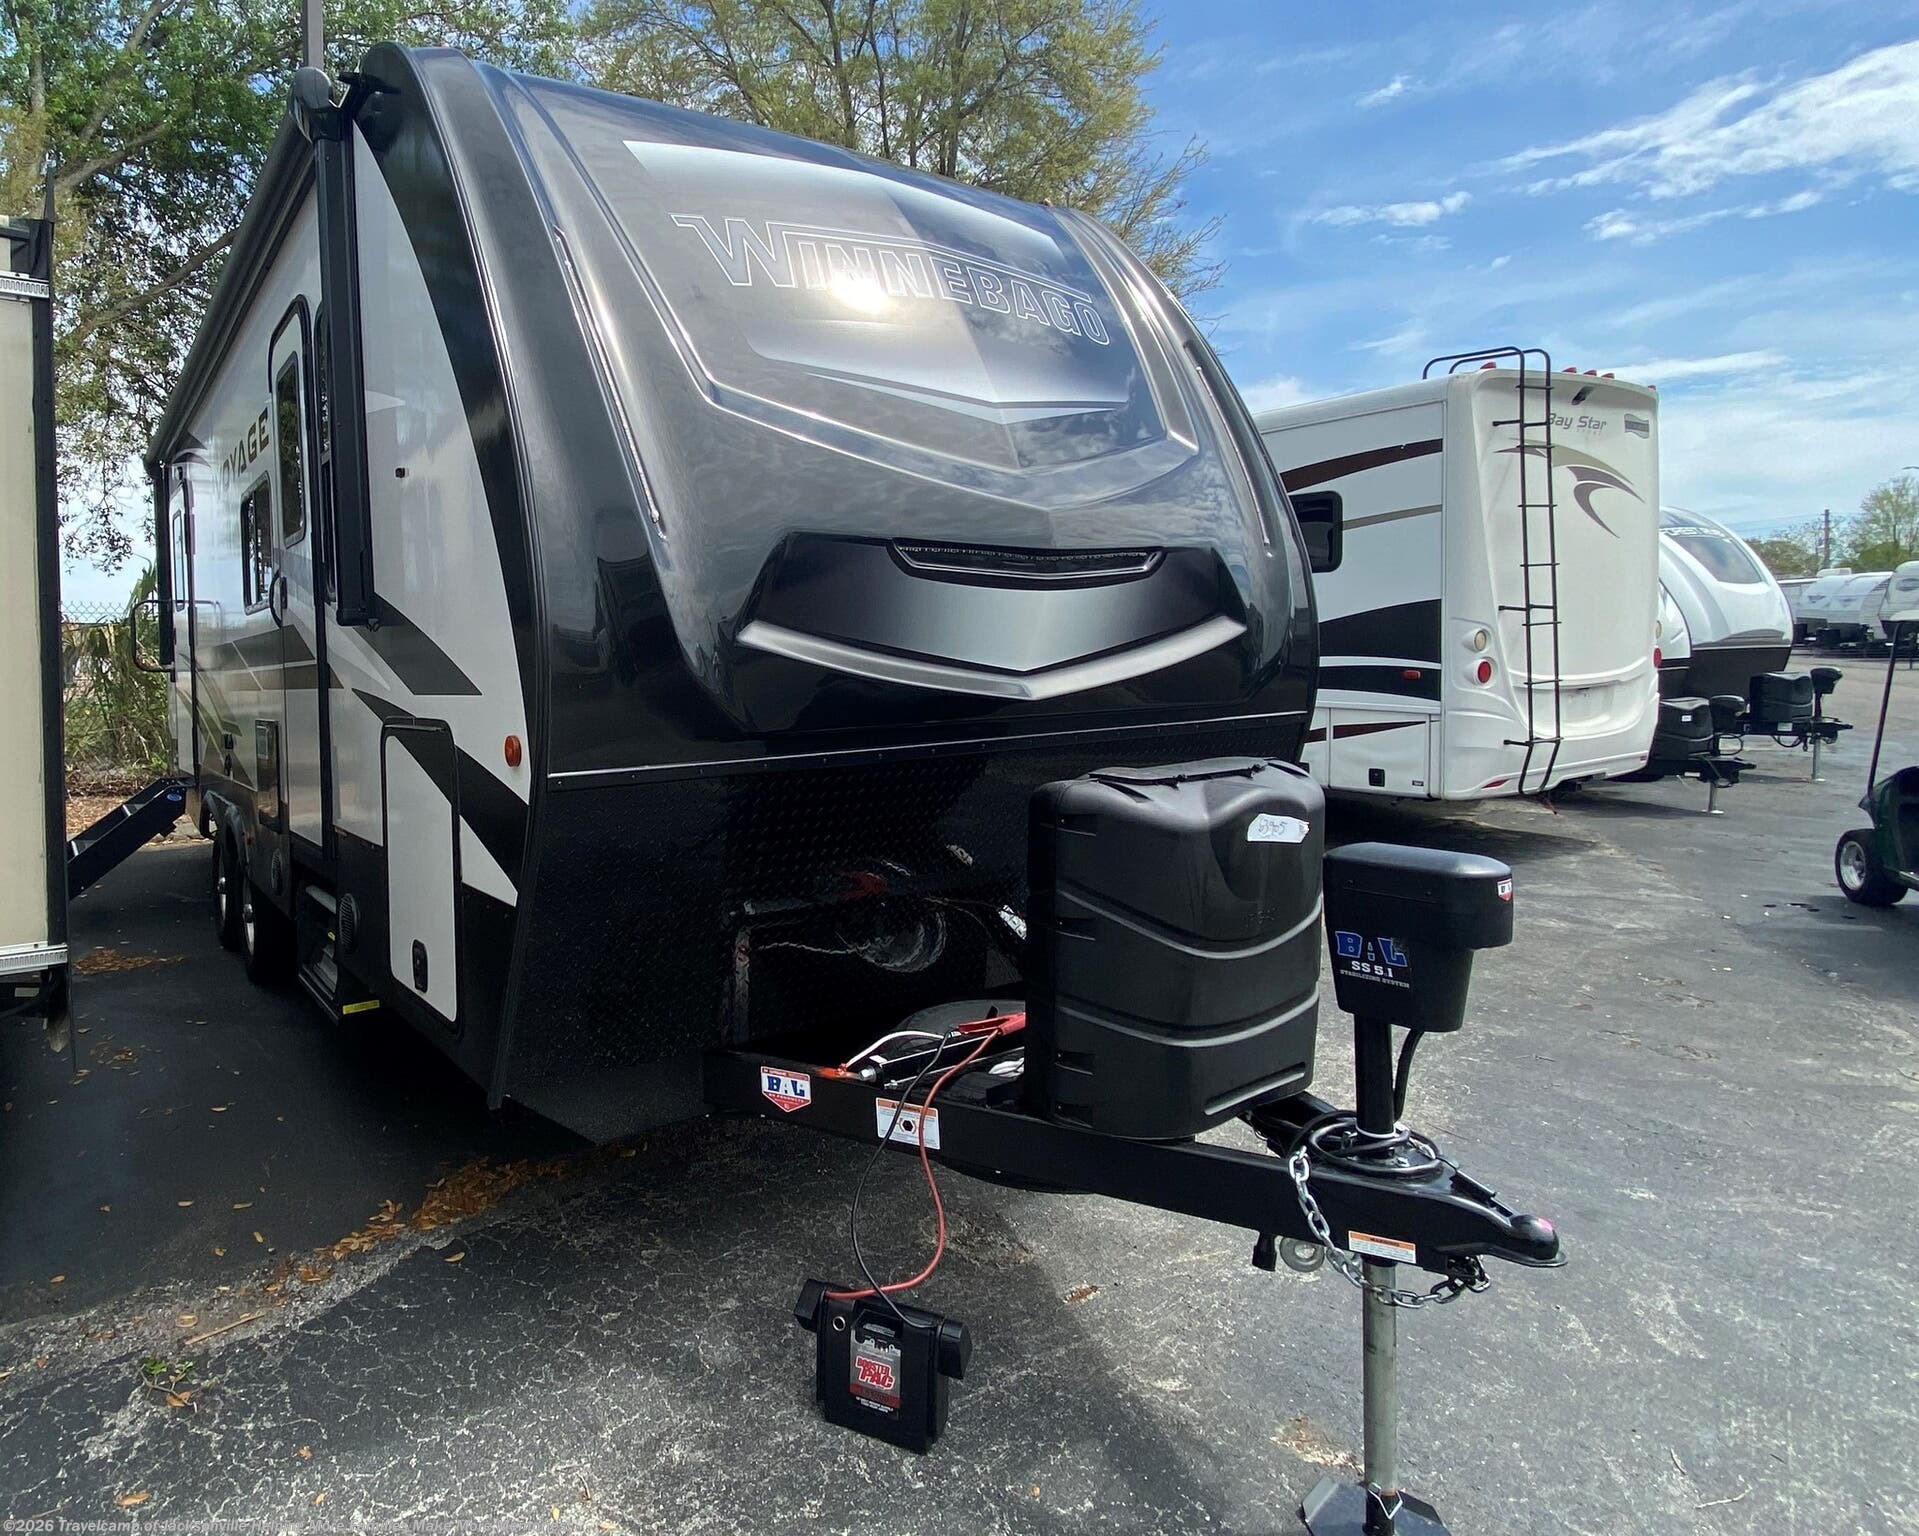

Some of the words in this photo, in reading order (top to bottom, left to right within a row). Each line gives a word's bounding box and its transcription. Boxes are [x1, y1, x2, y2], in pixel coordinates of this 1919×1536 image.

[670, 213, 1110, 346] WINNEBAGO
[1549, 412, 1573, 430] Bay
[1577, 416, 1607, 430] Star
